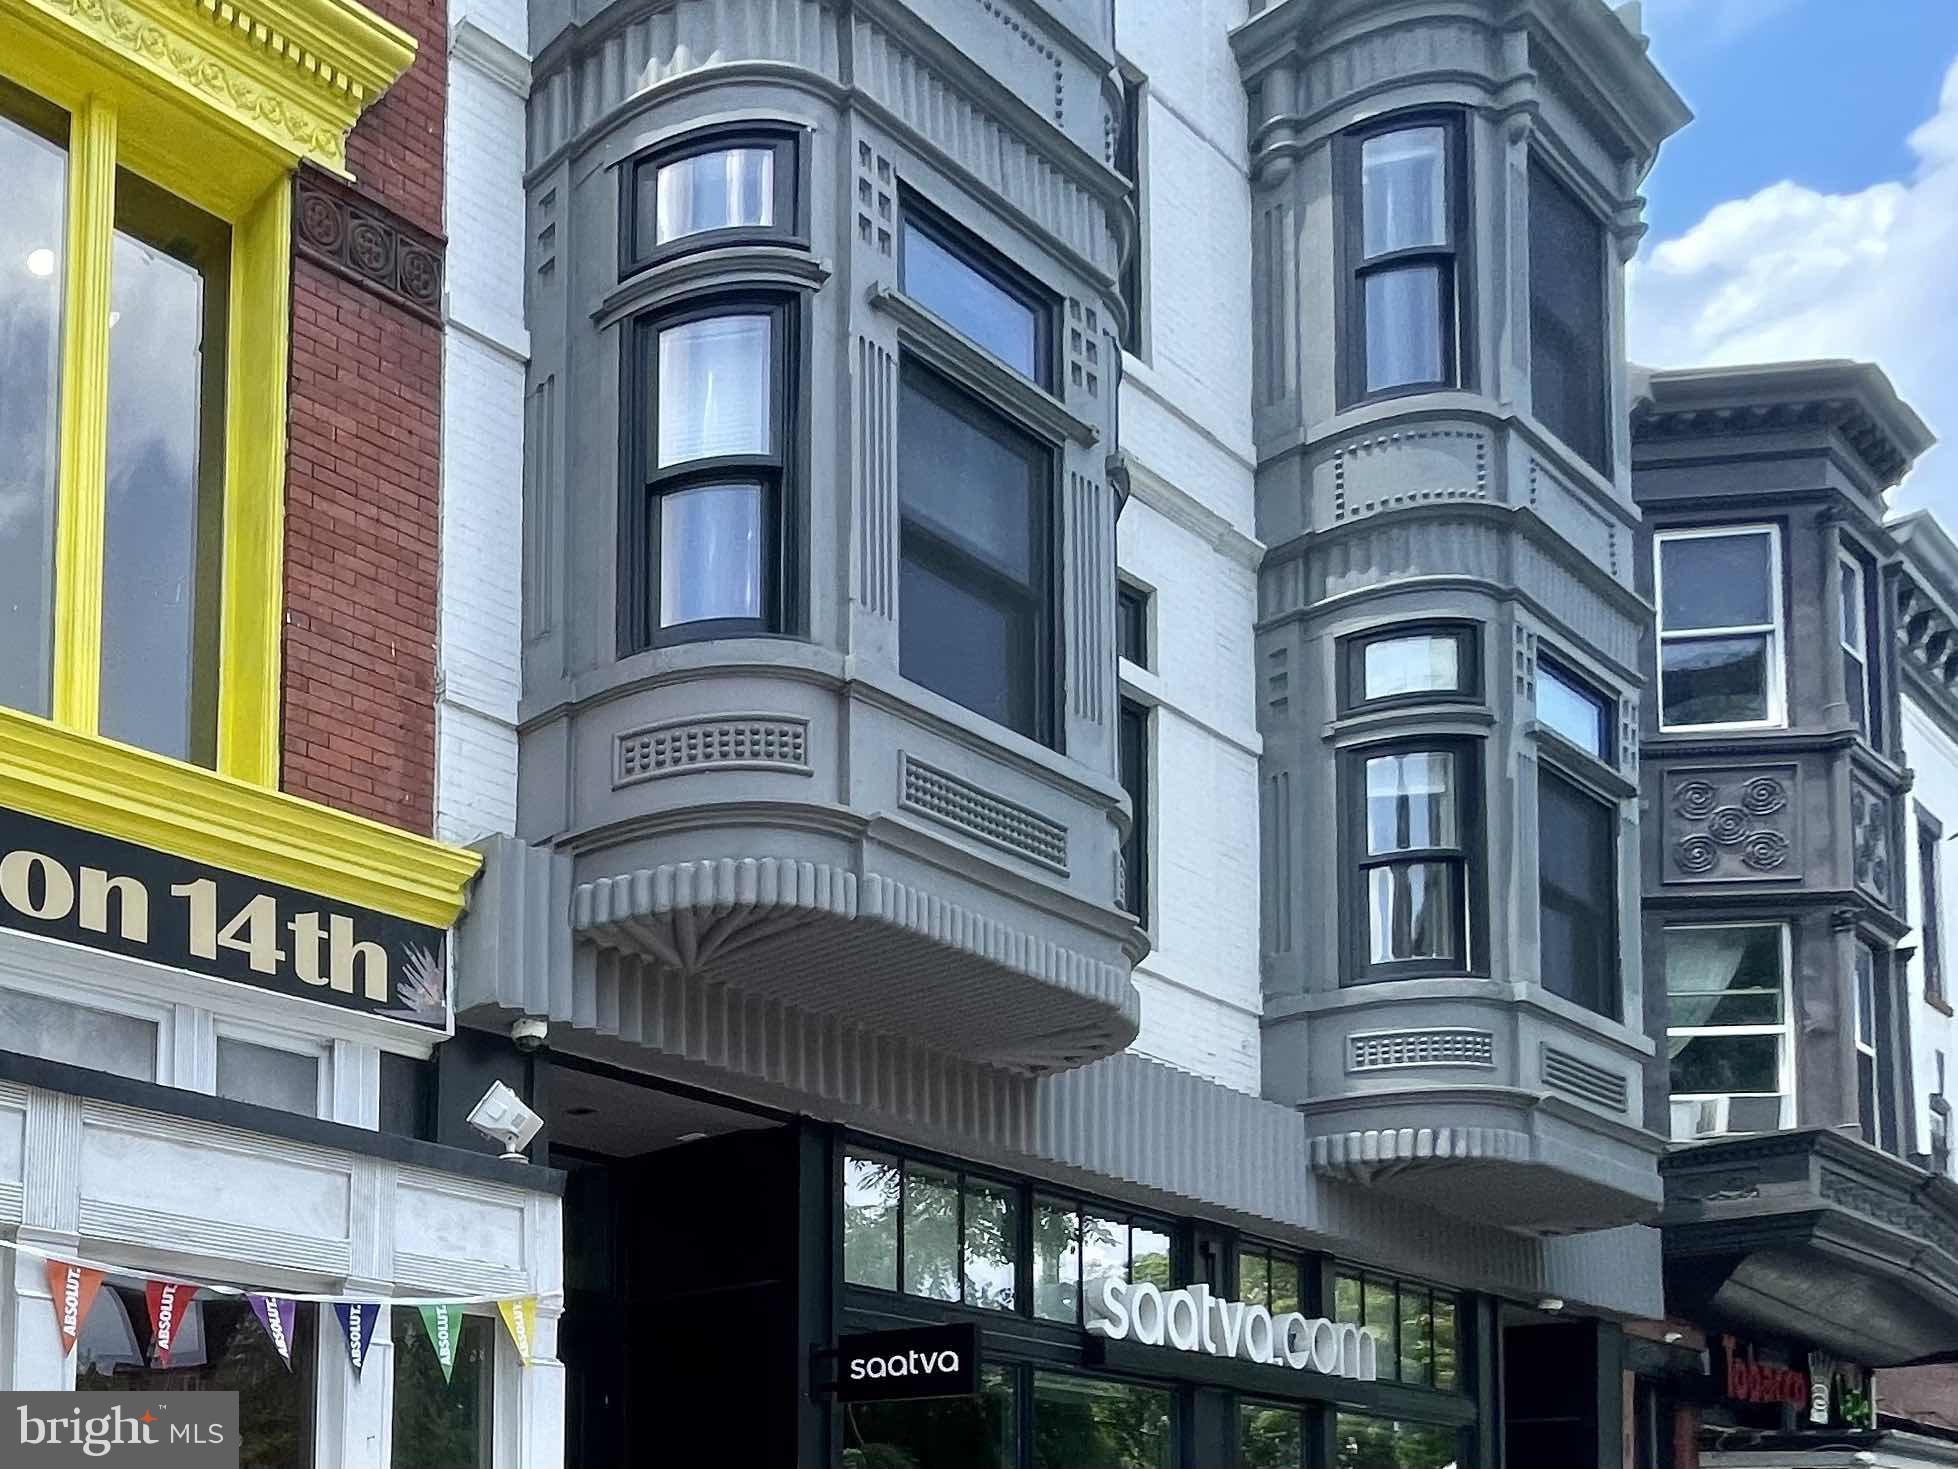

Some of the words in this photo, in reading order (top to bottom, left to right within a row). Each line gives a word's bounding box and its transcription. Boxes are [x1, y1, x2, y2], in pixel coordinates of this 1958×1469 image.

[0, 850, 149, 944] on
[170, 878, 388, 1003] 14th
[850, 1350, 960, 1380] saatva
[1086, 1277, 1376, 1382] saatva.com
